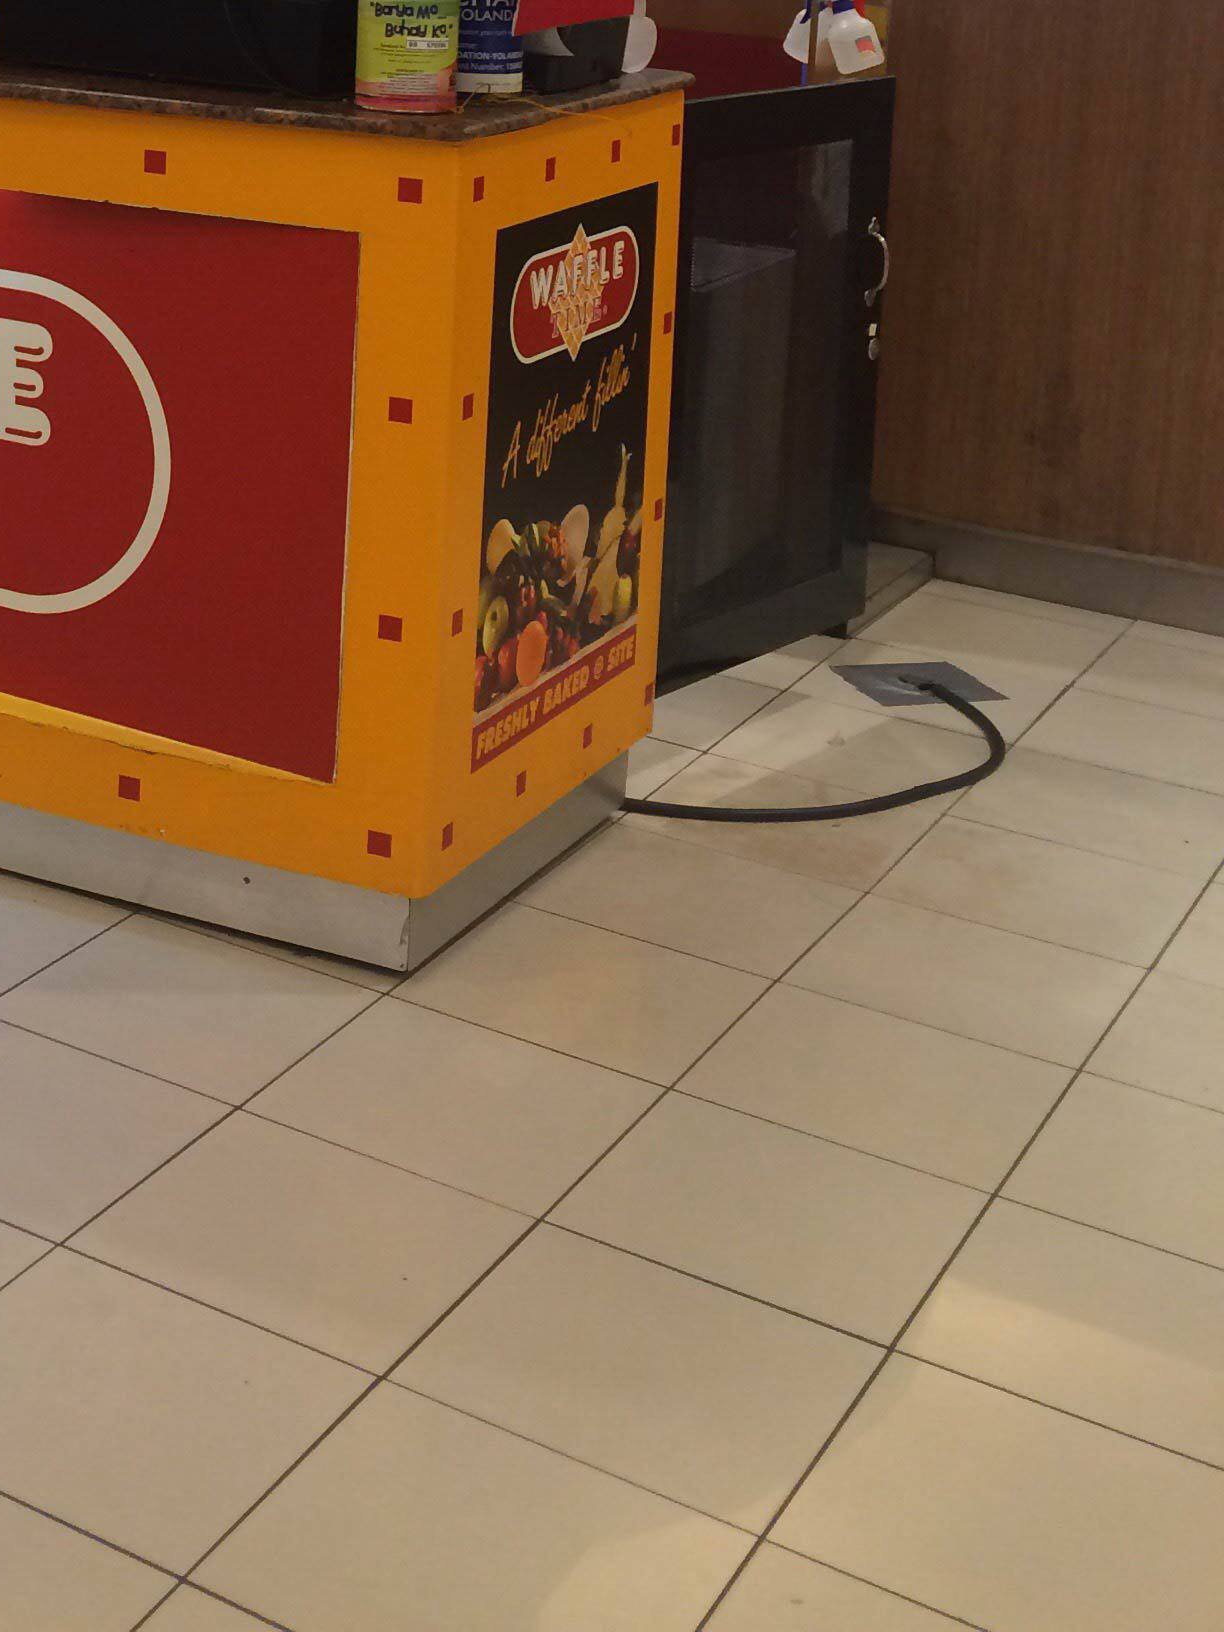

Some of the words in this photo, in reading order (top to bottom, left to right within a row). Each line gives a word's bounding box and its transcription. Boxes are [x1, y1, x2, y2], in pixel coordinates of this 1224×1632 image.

[384, 18, 428, 38] Buhay
[461, 8, 514, 21] OLAND
[530, 240, 625, 310] WAFFLE
[501, 420, 521, 489] A
[527, 379, 591, 478] different
[476, 696, 540, 760] FRESHLY
[542, 665, 590, 715] BAKED
[607, 634, 635, 672] SITE
